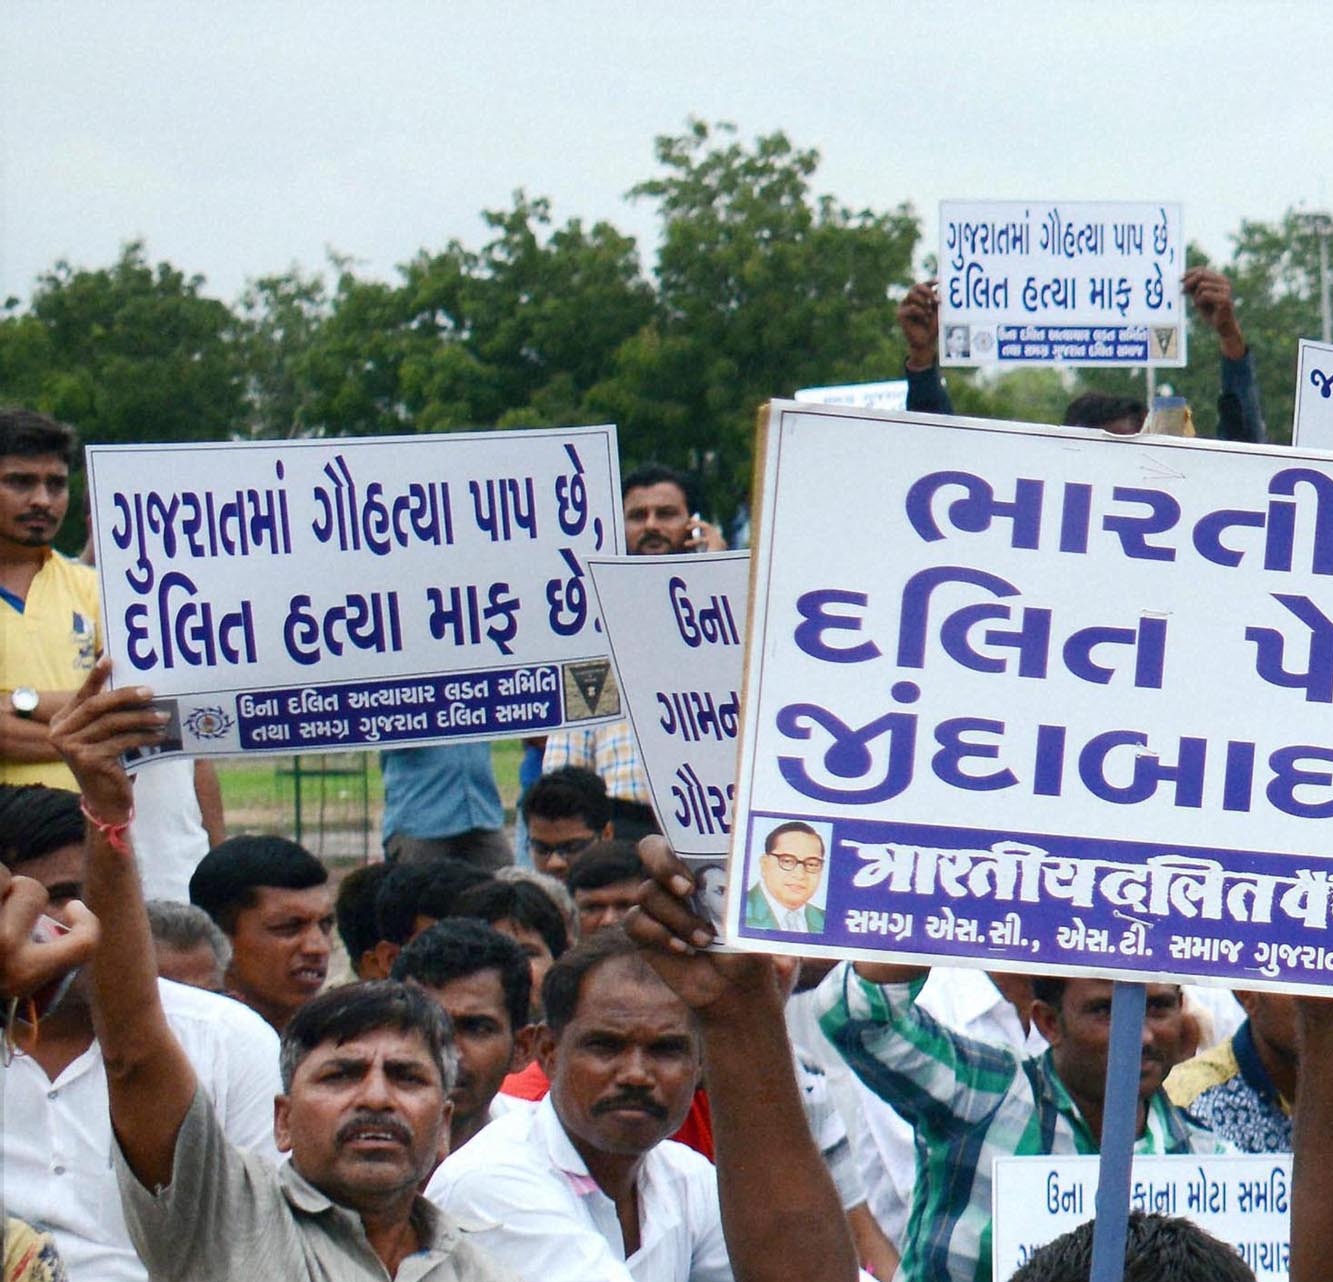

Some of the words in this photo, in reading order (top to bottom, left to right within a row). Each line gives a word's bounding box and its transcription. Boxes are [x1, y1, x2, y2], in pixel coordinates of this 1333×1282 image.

[947, 210, 1029, 271] ગુજરાતમાં
[1040, 208, 1103, 258] ગૌહત્યા
[1114, 224, 1142, 255] પાપ
[950, 262, 1008, 308] દલિત
[1023, 277, 1075, 312] હત્યા
[1090, 278, 1131, 316] માફ
[1146, 263, 1171, 309] છે.
[112, 460, 291, 594] ગુજરાતમાં
[312, 455, 453, 555] ગૌહત્યા
[469, 478, 537, 541] પાપ
[555, 444, 603, 551] છે,
[125, 572, 257, 670] દલિત
[284, 592, 402, 665] હત્યા
[427, 583, 520, 655] માફ
[669, 577, 739, 647] ઉના
[794, 566, 1167, 689] દલિત
[240, 695, 278, 718] ઉના
[288, 689, 338, 714] દલિત
[348, 686, 435, 708] અત્યાચાર
[445, 680, 488, 700] લડત
[498, 667, 556, 695] સમિતિ
[253, 719, 290, 741] તથા
[301, 716, 350, 740] સમગ્ર
[359, 712, 427, 741] ગુજરાત
[437, 702, 486, 727] દલિત
[496, 702, 549, 722] સમાજ
[845, 910, 912, 941] સમગ્ર
[1169, 935, 1244, 962] સમાજ
[1048, 1171, 1082, 1214] ઉના
[1188, 1167, 1226, 1213] મોટા
